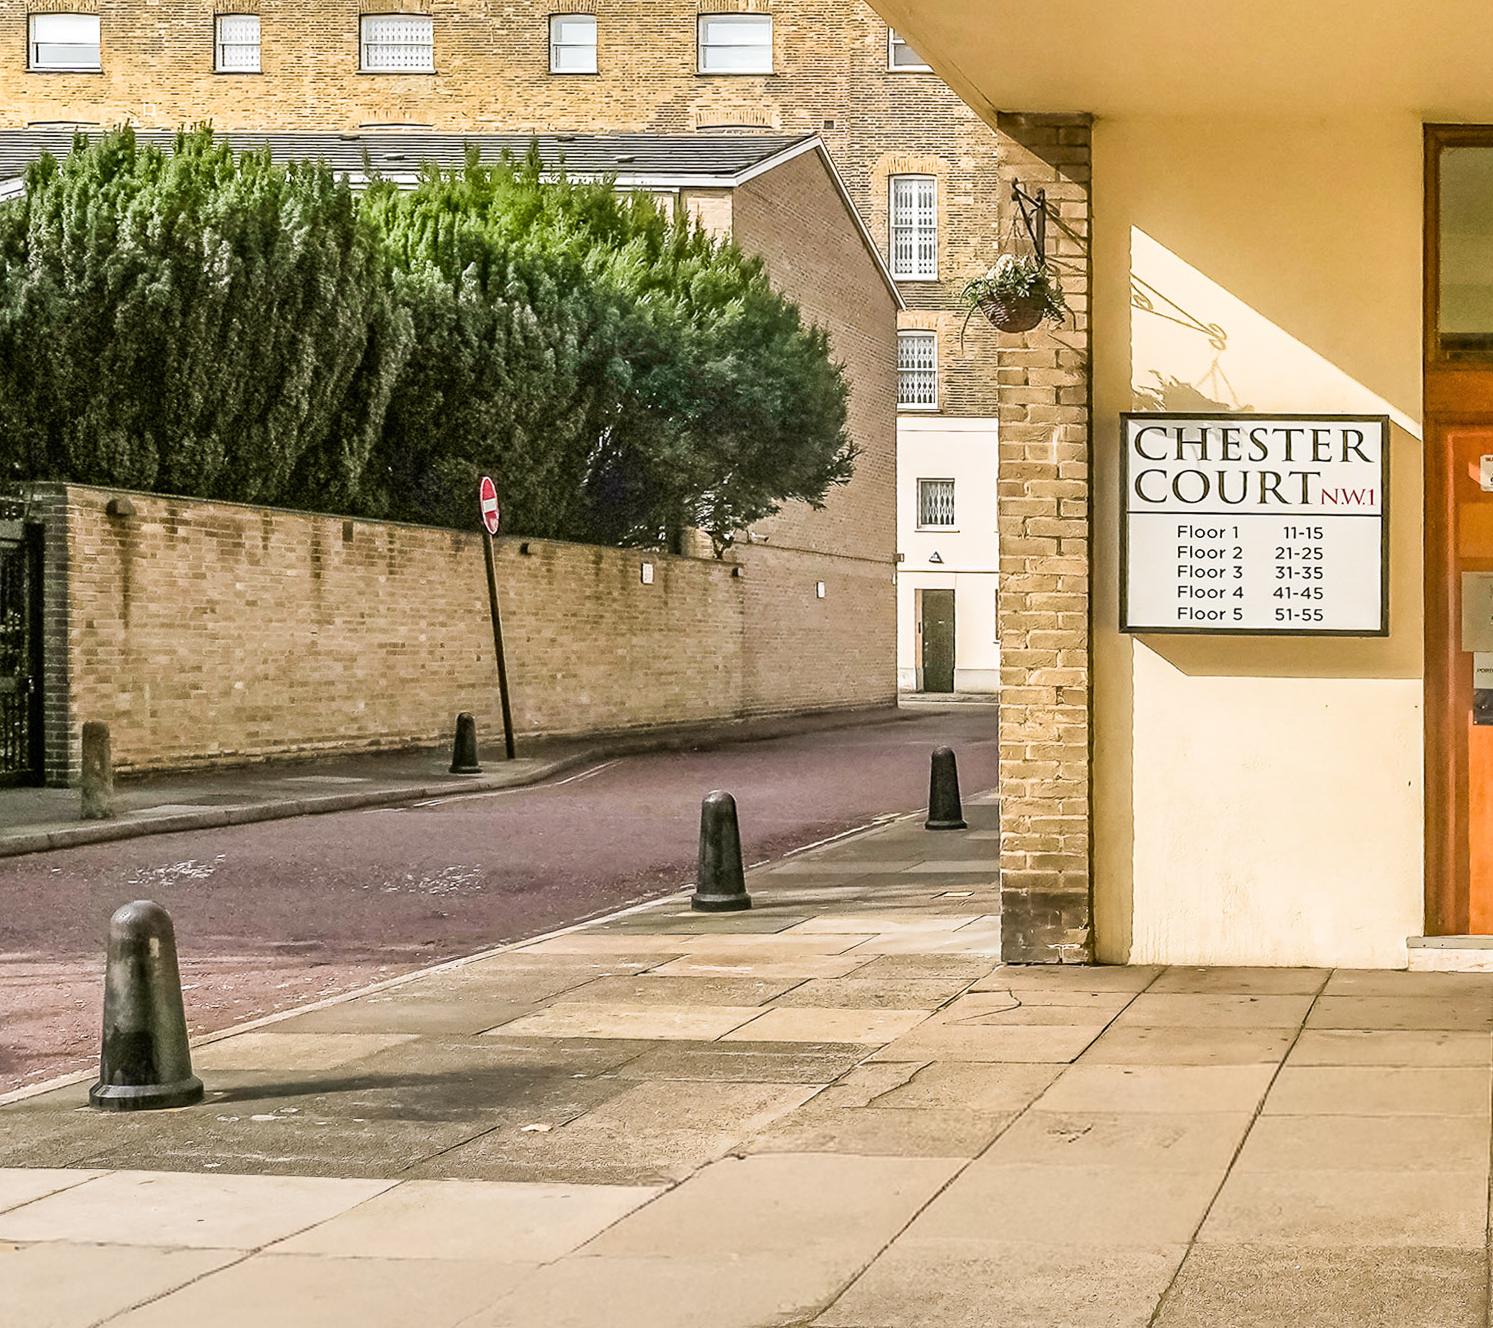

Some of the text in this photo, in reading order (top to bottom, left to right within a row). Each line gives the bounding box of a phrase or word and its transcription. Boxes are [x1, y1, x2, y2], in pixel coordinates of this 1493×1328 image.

[1133, 426, 1375, 463] CHESTER
[1134, 469, 1322, 505] COURT
[1177, 525, 1226, 539] Floor
[1283, 526, 1324, 540] 11-15
[1177, 546, 1324, 561] Floor 2 21-25
[1177, 565, 1324, 581] Floor 3 31-35
[1177, 585, 1324, 600] Floor 4 41-45
[1177, 607, 1324, 622] Floor 5 51-55
